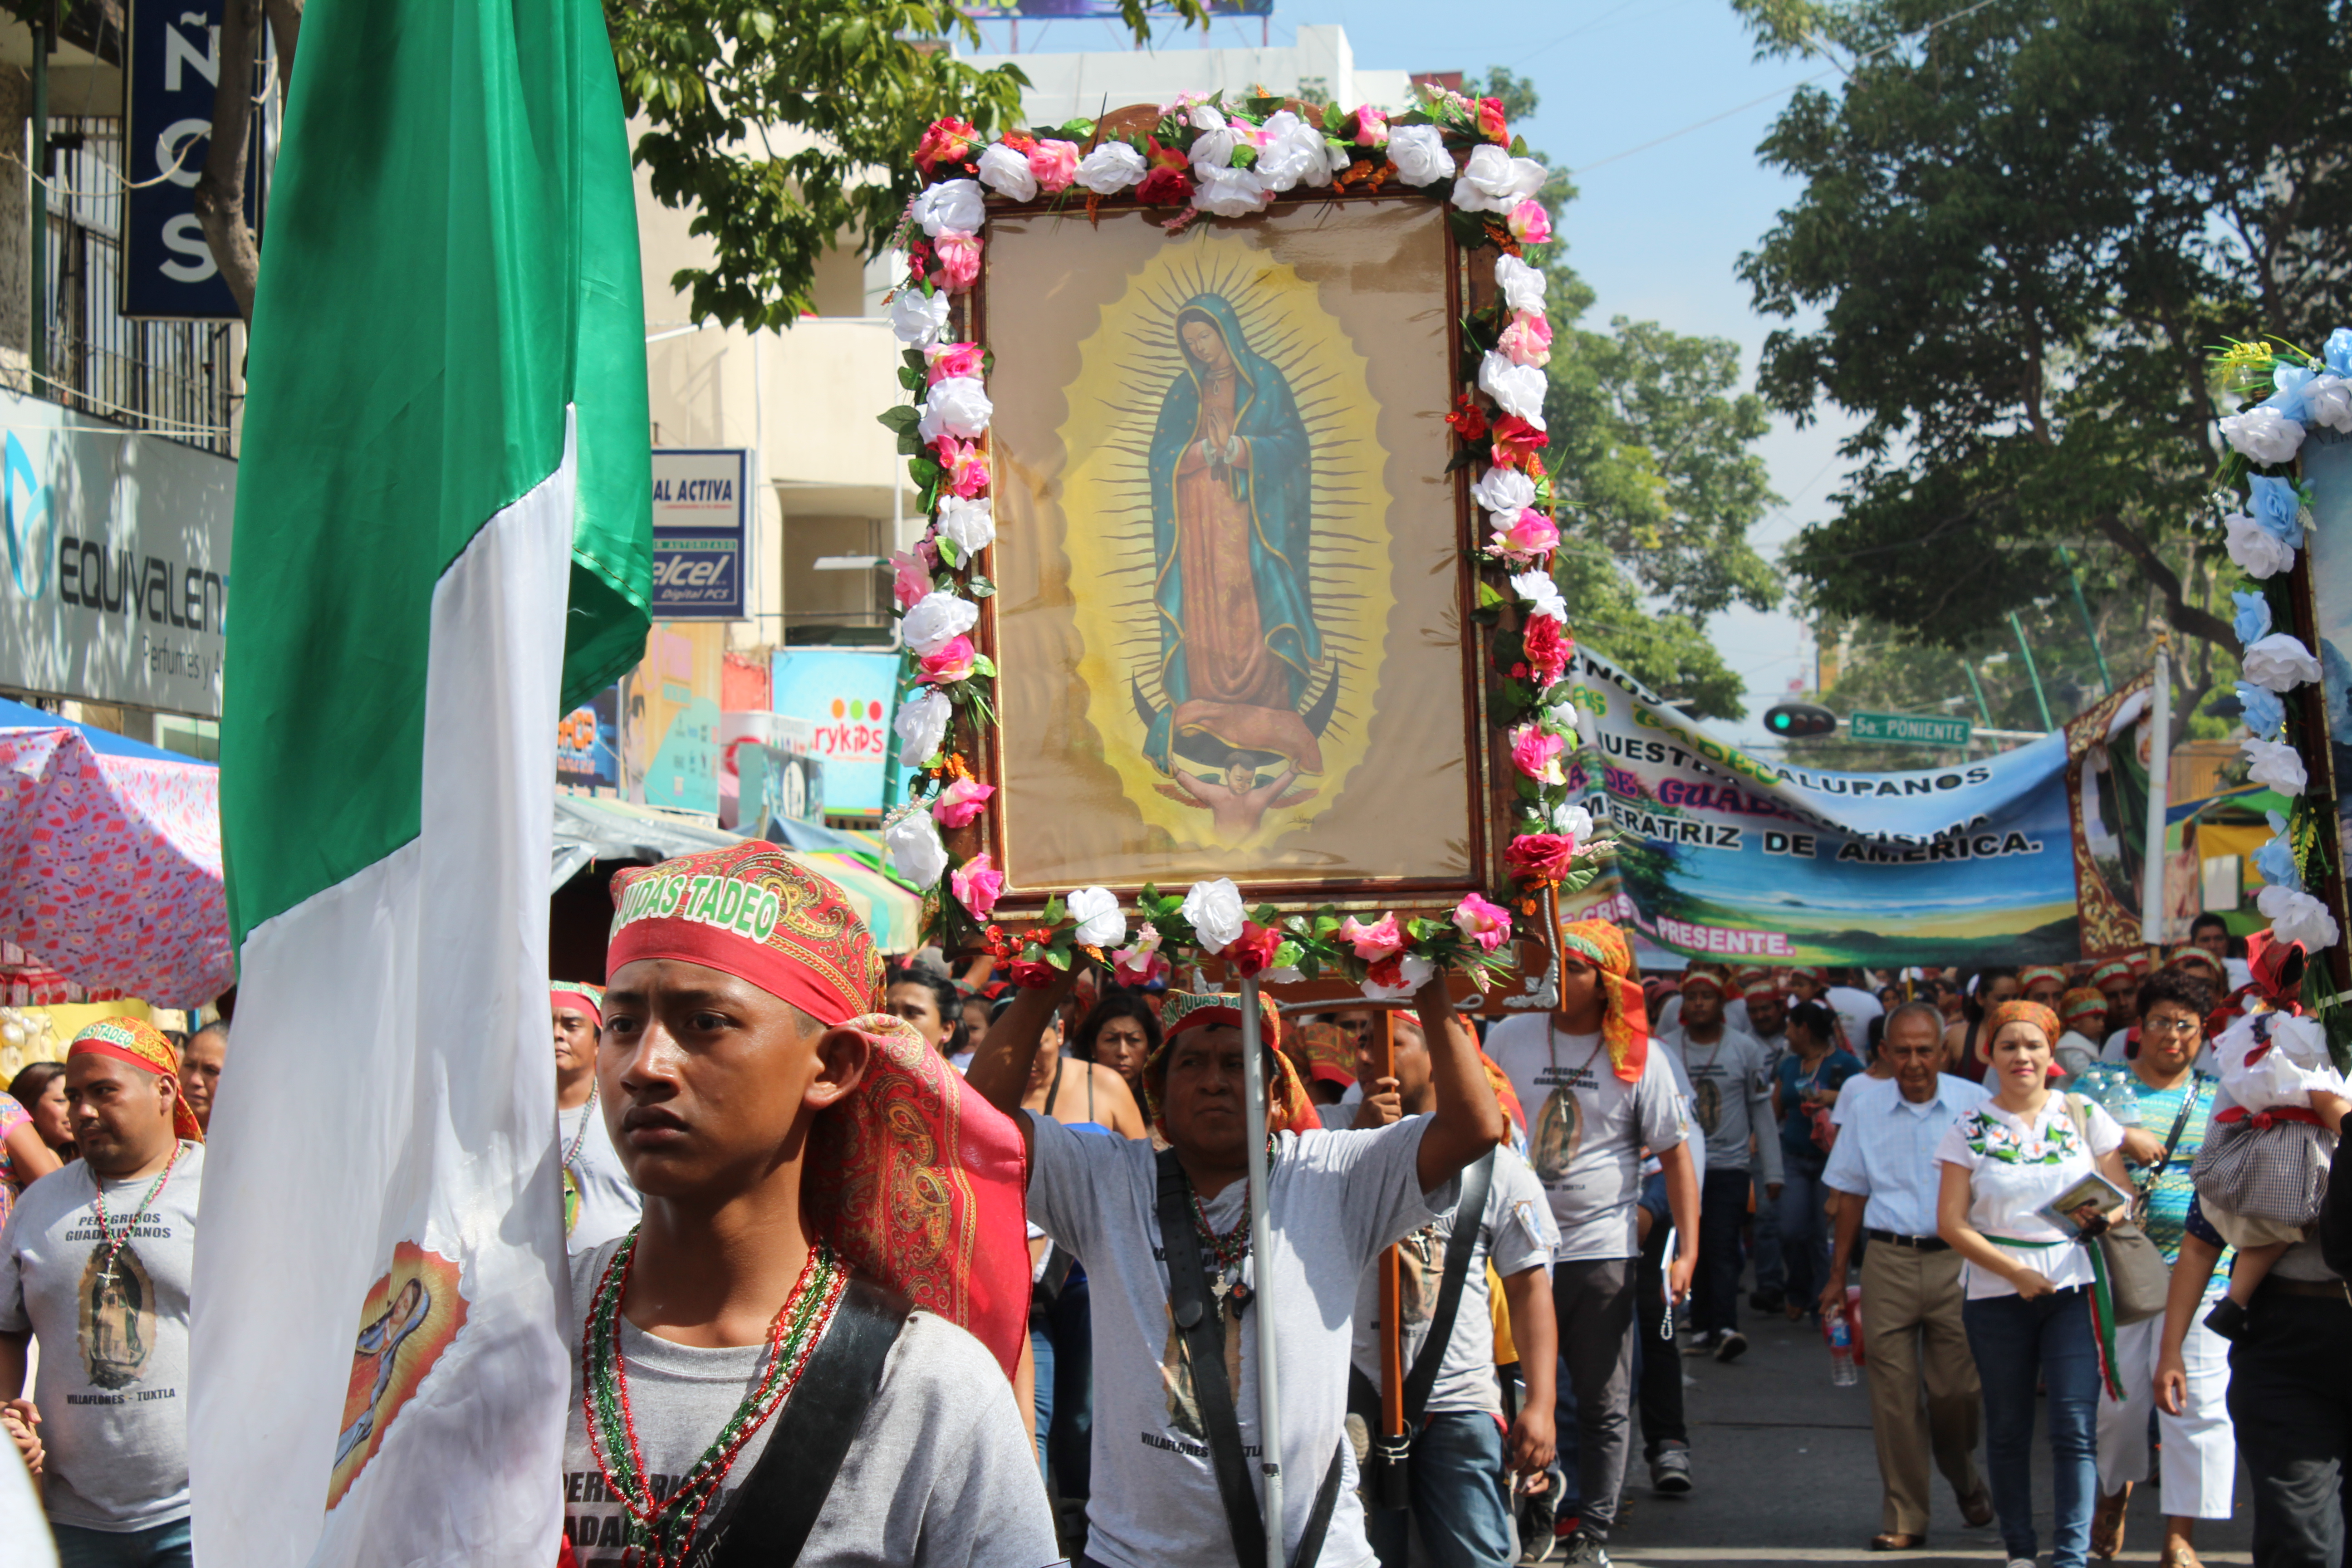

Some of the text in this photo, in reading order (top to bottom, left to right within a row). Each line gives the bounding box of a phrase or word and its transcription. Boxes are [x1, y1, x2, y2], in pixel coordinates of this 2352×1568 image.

[676, 480, 732, 501] ACTIVA
[661, 588, 730, 601] Digital PCS
[143, 635, 200, 680] Perfumes
[202, 656, 211, 691] y
[1856, 717, 1964, 742] 5a. PONIENTE
[1764, 831, 1814, 857] DE
[684, 876, 779, 944] TADEO
[1657, 916, 1795, 957] PRESENTE.
[1179, 994, 1220, 1017] JUDAS
[95, 1023, 135, 1049] TADEO
[67, 1394, 125, 1405] VILLAFLORES
[137, 1388, 176, 1401] TUXTLA
[1140, 1431, 1209, 1458] VILLAFLORES
